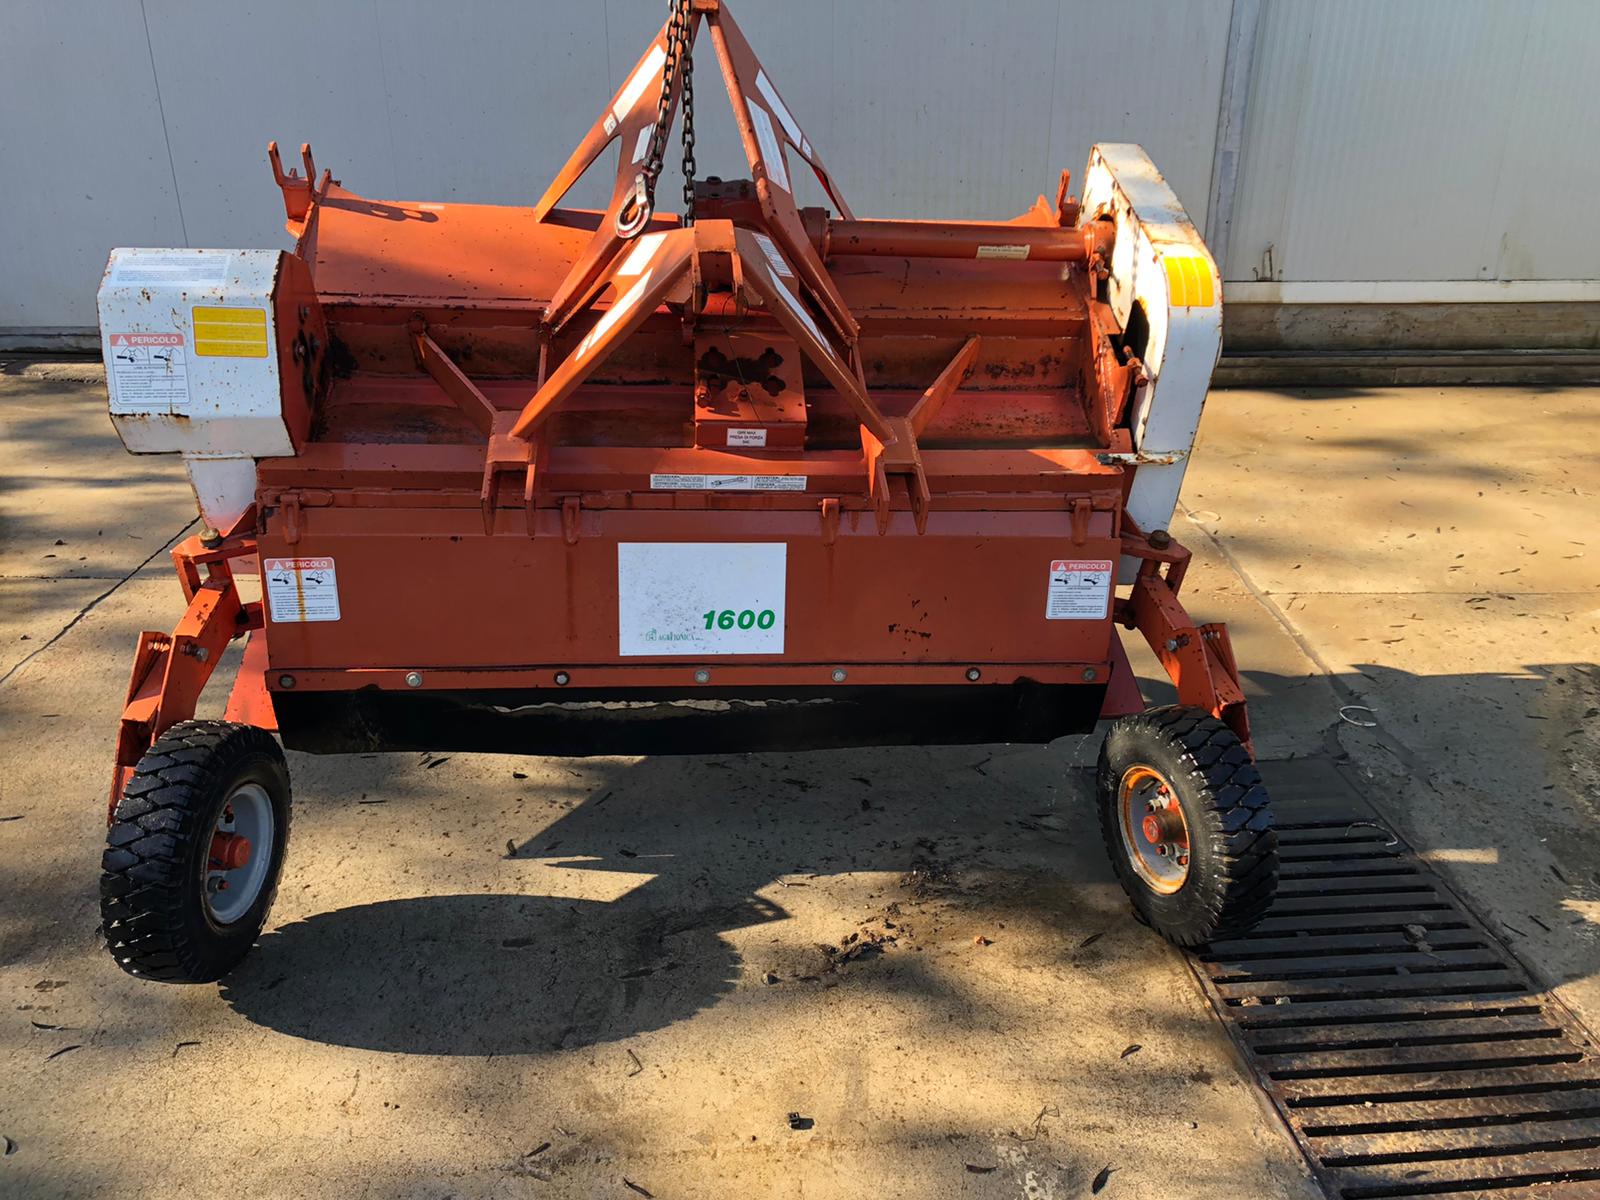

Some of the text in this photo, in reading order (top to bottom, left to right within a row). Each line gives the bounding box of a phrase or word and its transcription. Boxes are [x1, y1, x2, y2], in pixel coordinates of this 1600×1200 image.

[131, 336, 178, 344] PERICOLO
[285, 560, 328, 568] PERICOLO
[703, 609, 776, 630] 1600
